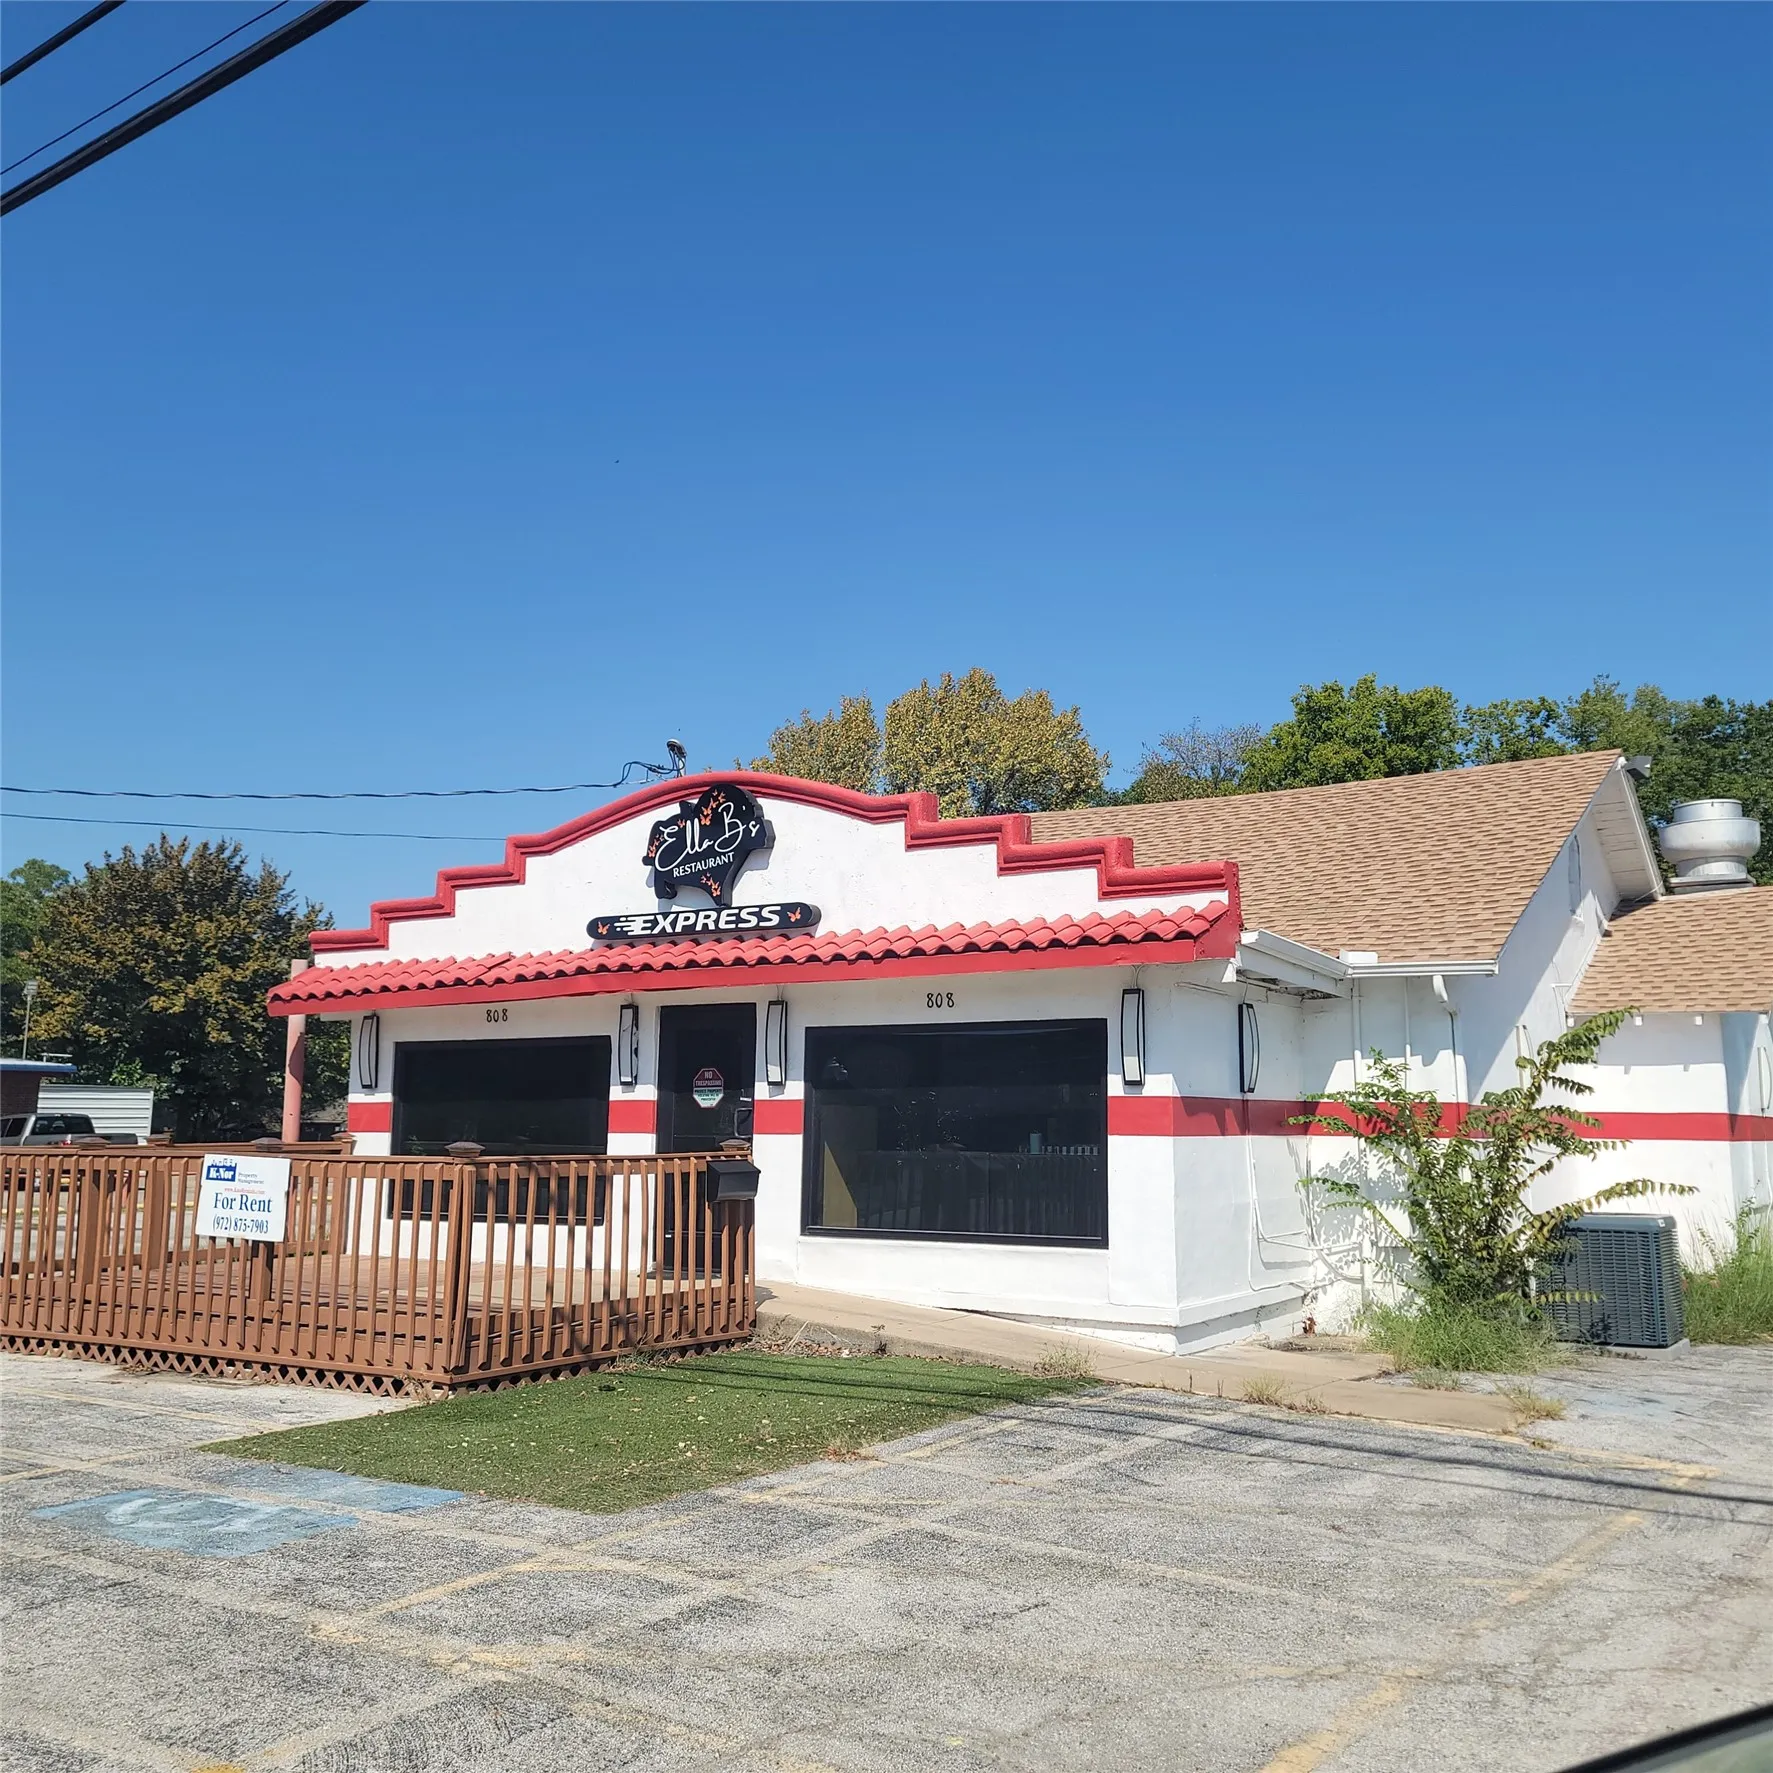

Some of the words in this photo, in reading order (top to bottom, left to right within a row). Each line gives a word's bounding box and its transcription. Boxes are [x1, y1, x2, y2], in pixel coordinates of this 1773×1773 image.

[654, 819, 716, 872] Ella
[672, 852, 735, 878] RESTAURANT
[616, 905, 782, 936] EXPRESS
[926, 992, 955, 1009] 808
[486, 1008, 508, 1023] 808
[704, 1071, 712, 1079] NO
[213, 1192, 236, 1210] For
[239, 1194, 272, 1213] Rent
[213, 1214, 232, 1232] (972)
[233, 1217, 269, 1234] 875-7903
